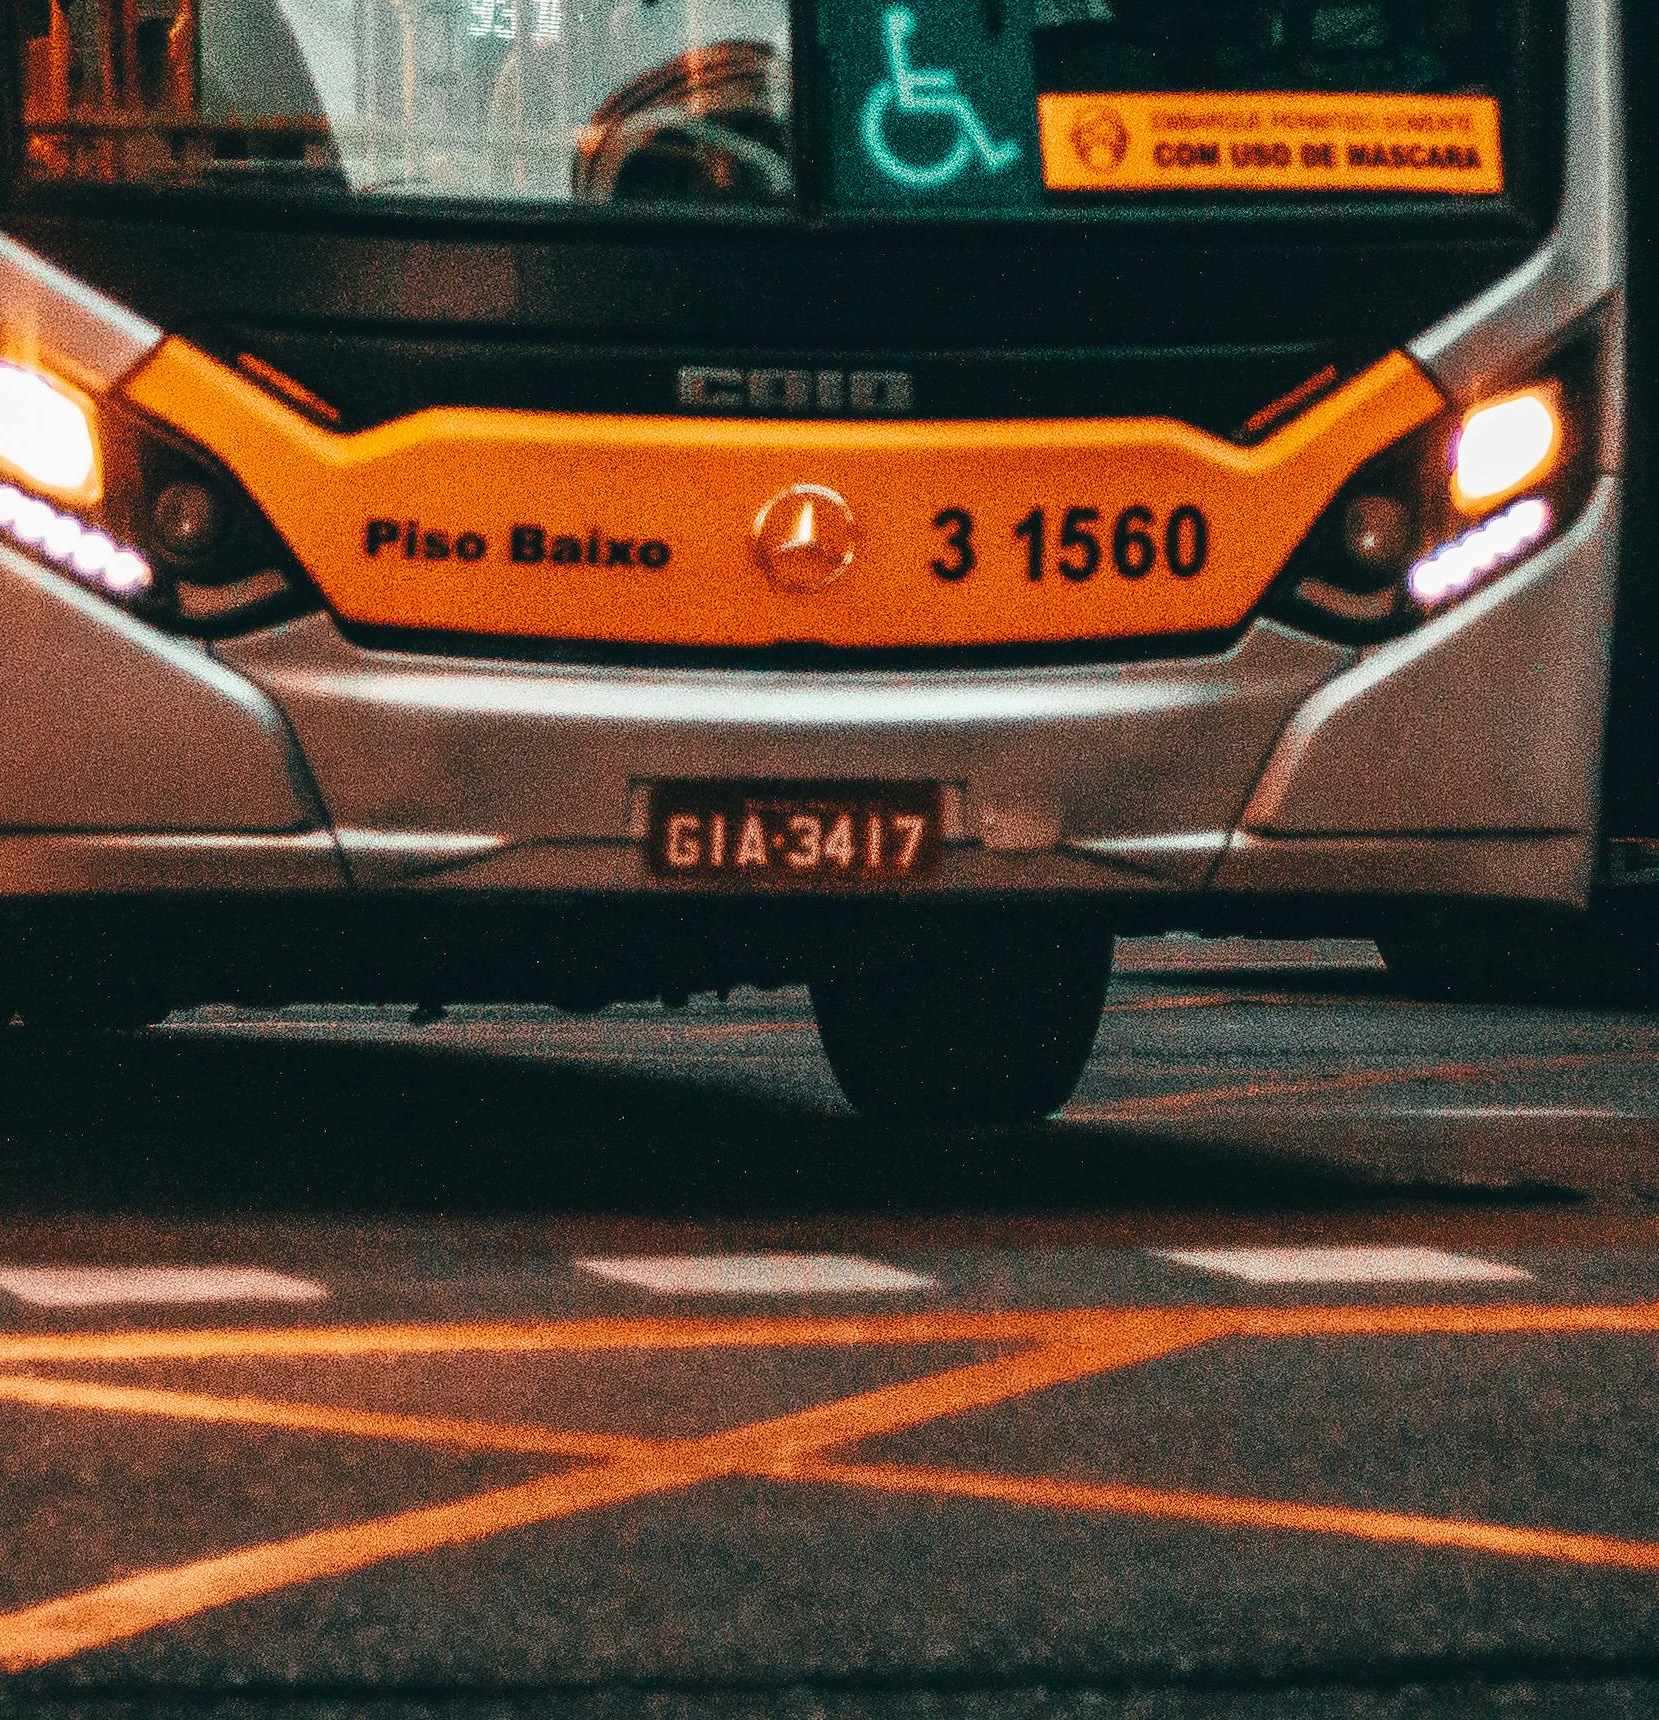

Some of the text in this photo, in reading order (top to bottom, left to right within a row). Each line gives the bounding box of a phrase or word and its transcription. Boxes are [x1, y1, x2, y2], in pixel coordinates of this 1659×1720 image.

[1153, 142, 1221, 170] COM
[1230, 142, 1292, 170] USO
[1301, 143, 1335, 169] DE
[365, 519, 673, 570] Piso Baixo
[931, 505, 1210, 582] 3 1560
